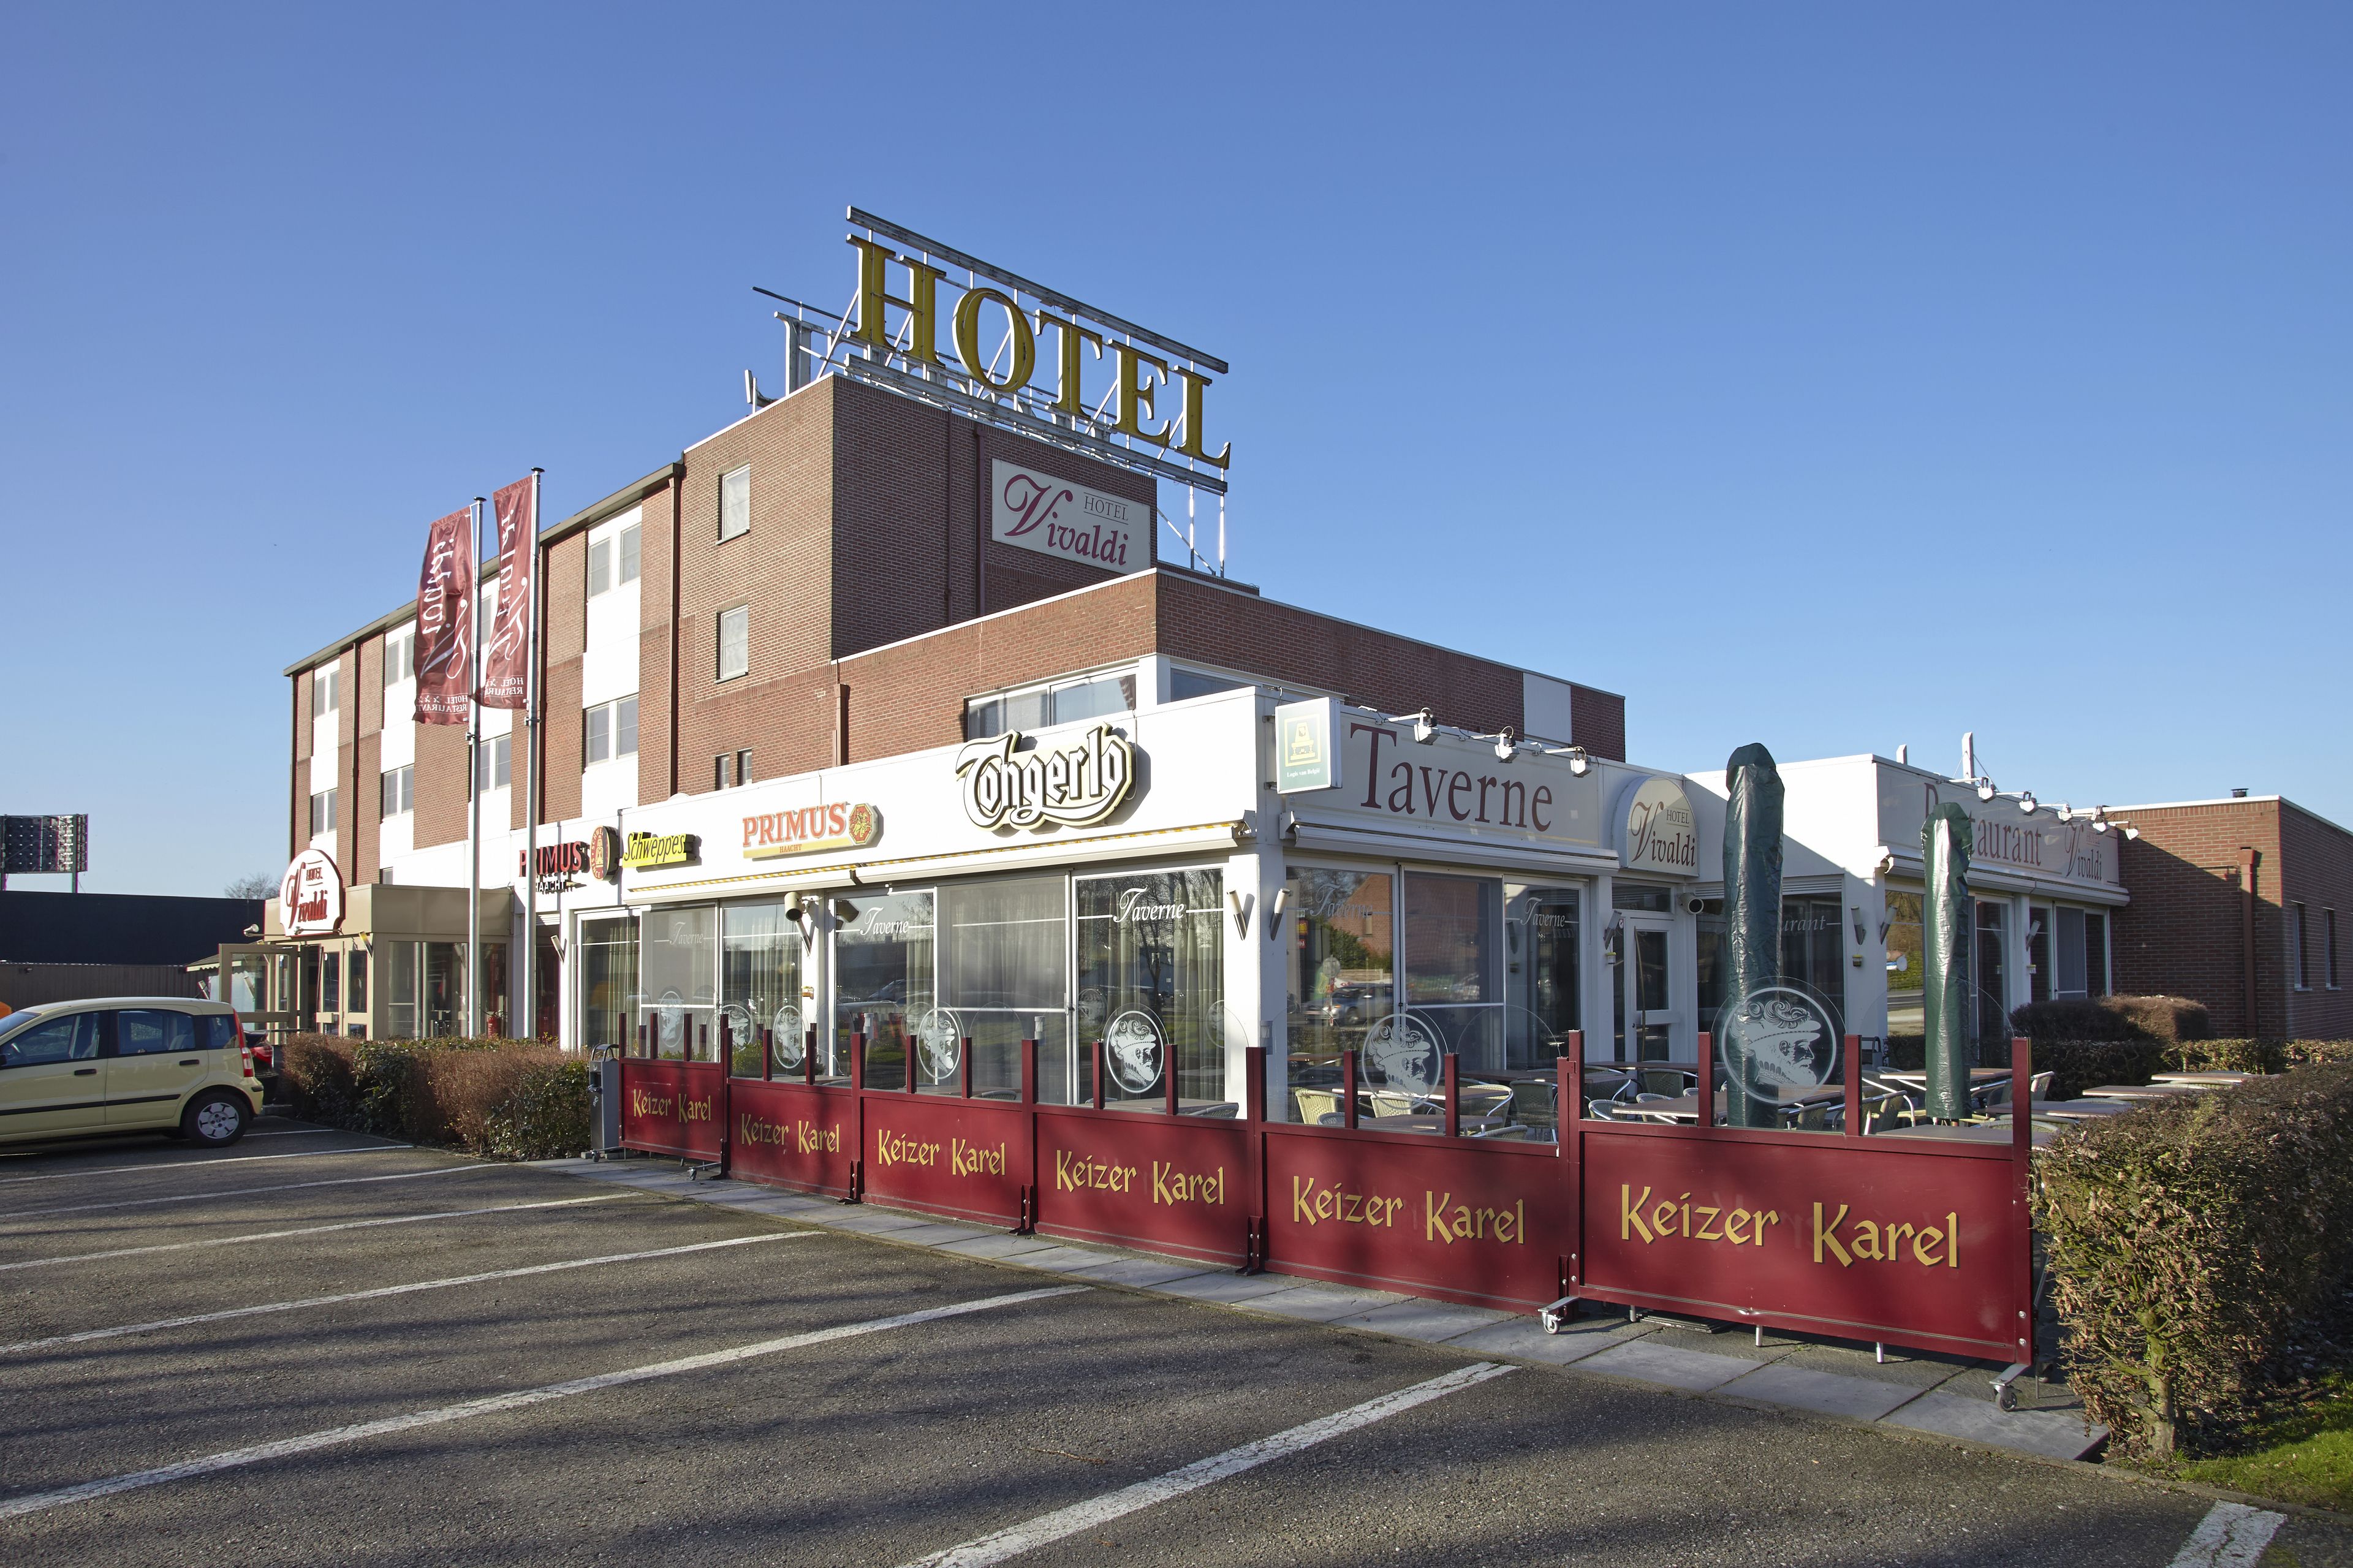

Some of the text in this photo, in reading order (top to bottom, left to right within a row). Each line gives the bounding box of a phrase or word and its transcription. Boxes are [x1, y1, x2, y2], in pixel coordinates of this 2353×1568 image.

[846, 233, 1231, 470] HOTEL
[1004, 474, 1129, 566] Vivaldi
[1084, 496, 1128, 521] HOTEL
[955, 725, 1127, 827] Tongerlo
[1350, 722, 1553, 832] Taverne
[742, 801, 846, 847] PRIMUS
[1630, 801, 1696, 867] Vivaldi
[1666, 809, 1690, 824] HOTEL
[519, 841, 582, 877] PIMUS
[624, 832, 685, 863] Schweppes
[779, 844, 802, 853] HAACHT
[2064, 821, 2102, 881] Vivaldi
[860, 907, 909, 936] Taverne
[1113, 887, 1184, 923] Taverne
[1520, 897, 1566, 927] Taverne
[670, 922, 703, 945] Taverne
[634, 1088, 711, 1123] Keizer Karel
[741, 1113, 839, 1154] Keizer Karel
[878, 1129, 1005, 1177] Keizer Karel
[1056, 1149, 1224, 1206] Keizer Karel
[1294, 1175, 1525, 1244] Keizer Karel
[1621, 1183, 1960, 1268] Keizer Karel
